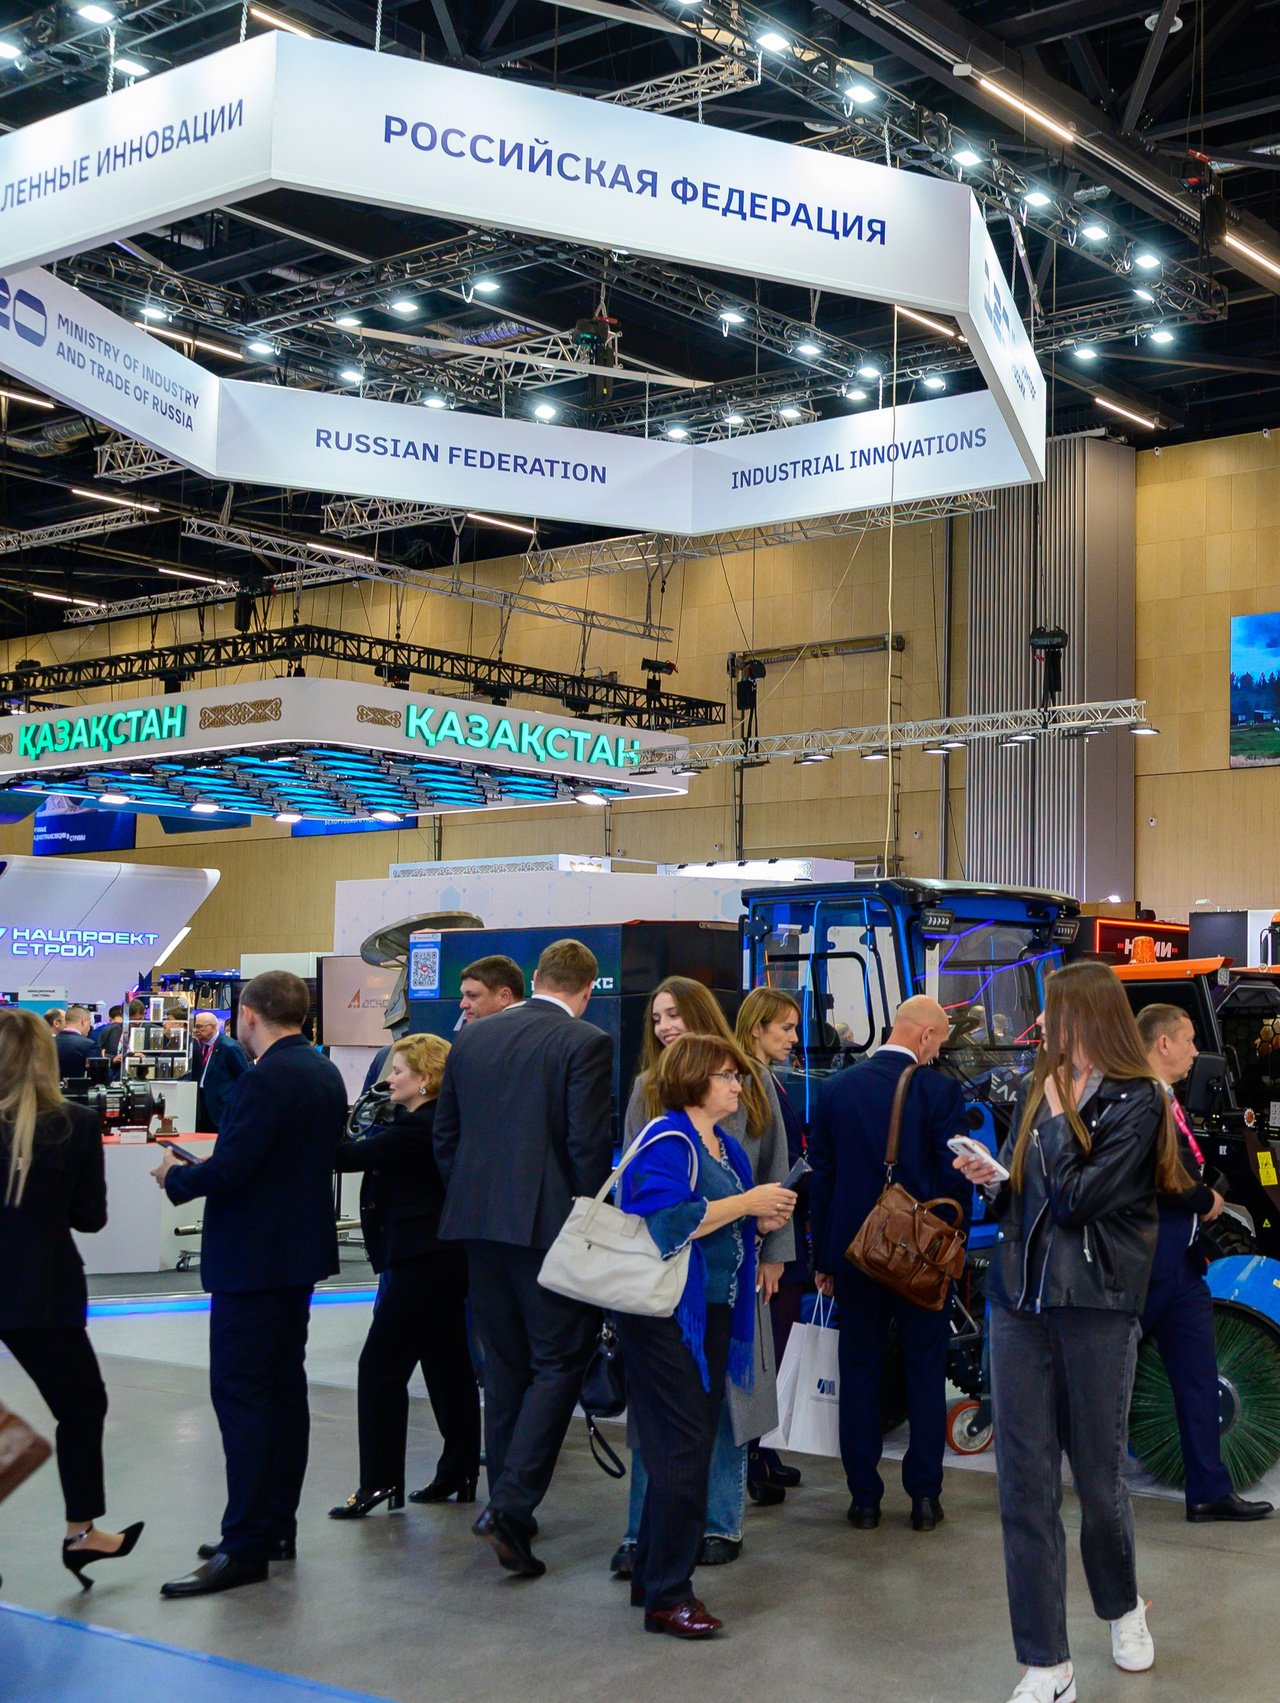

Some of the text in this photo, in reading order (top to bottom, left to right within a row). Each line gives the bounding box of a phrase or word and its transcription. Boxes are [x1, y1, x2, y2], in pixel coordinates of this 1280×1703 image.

[97, 98, 244, 177] ИННОВАЦИИ
[383, 114, 888, 246] РОССИЙСКАЯ ФЕДЕРАЦИЯ
[56, 341, 194, 432] AND TRADE OF RUSSIA
[57, 313, 200, 410] MINISTRY OF INDUSTRY
[315, 428, 608, 484] RUSSIAN FEDERATION
[731, 427, 988, 490] INDUSTRIAL INNOVATIONS
[18, 704, 188, 761] ҚАЗАҚСТАН
[406, 704, 641, 768] ҚАЗАҚСТАН
[12, 927, 159, 946] НАЦПРОЕКТ
[12, 940, 95, 958] СТРОЙ
